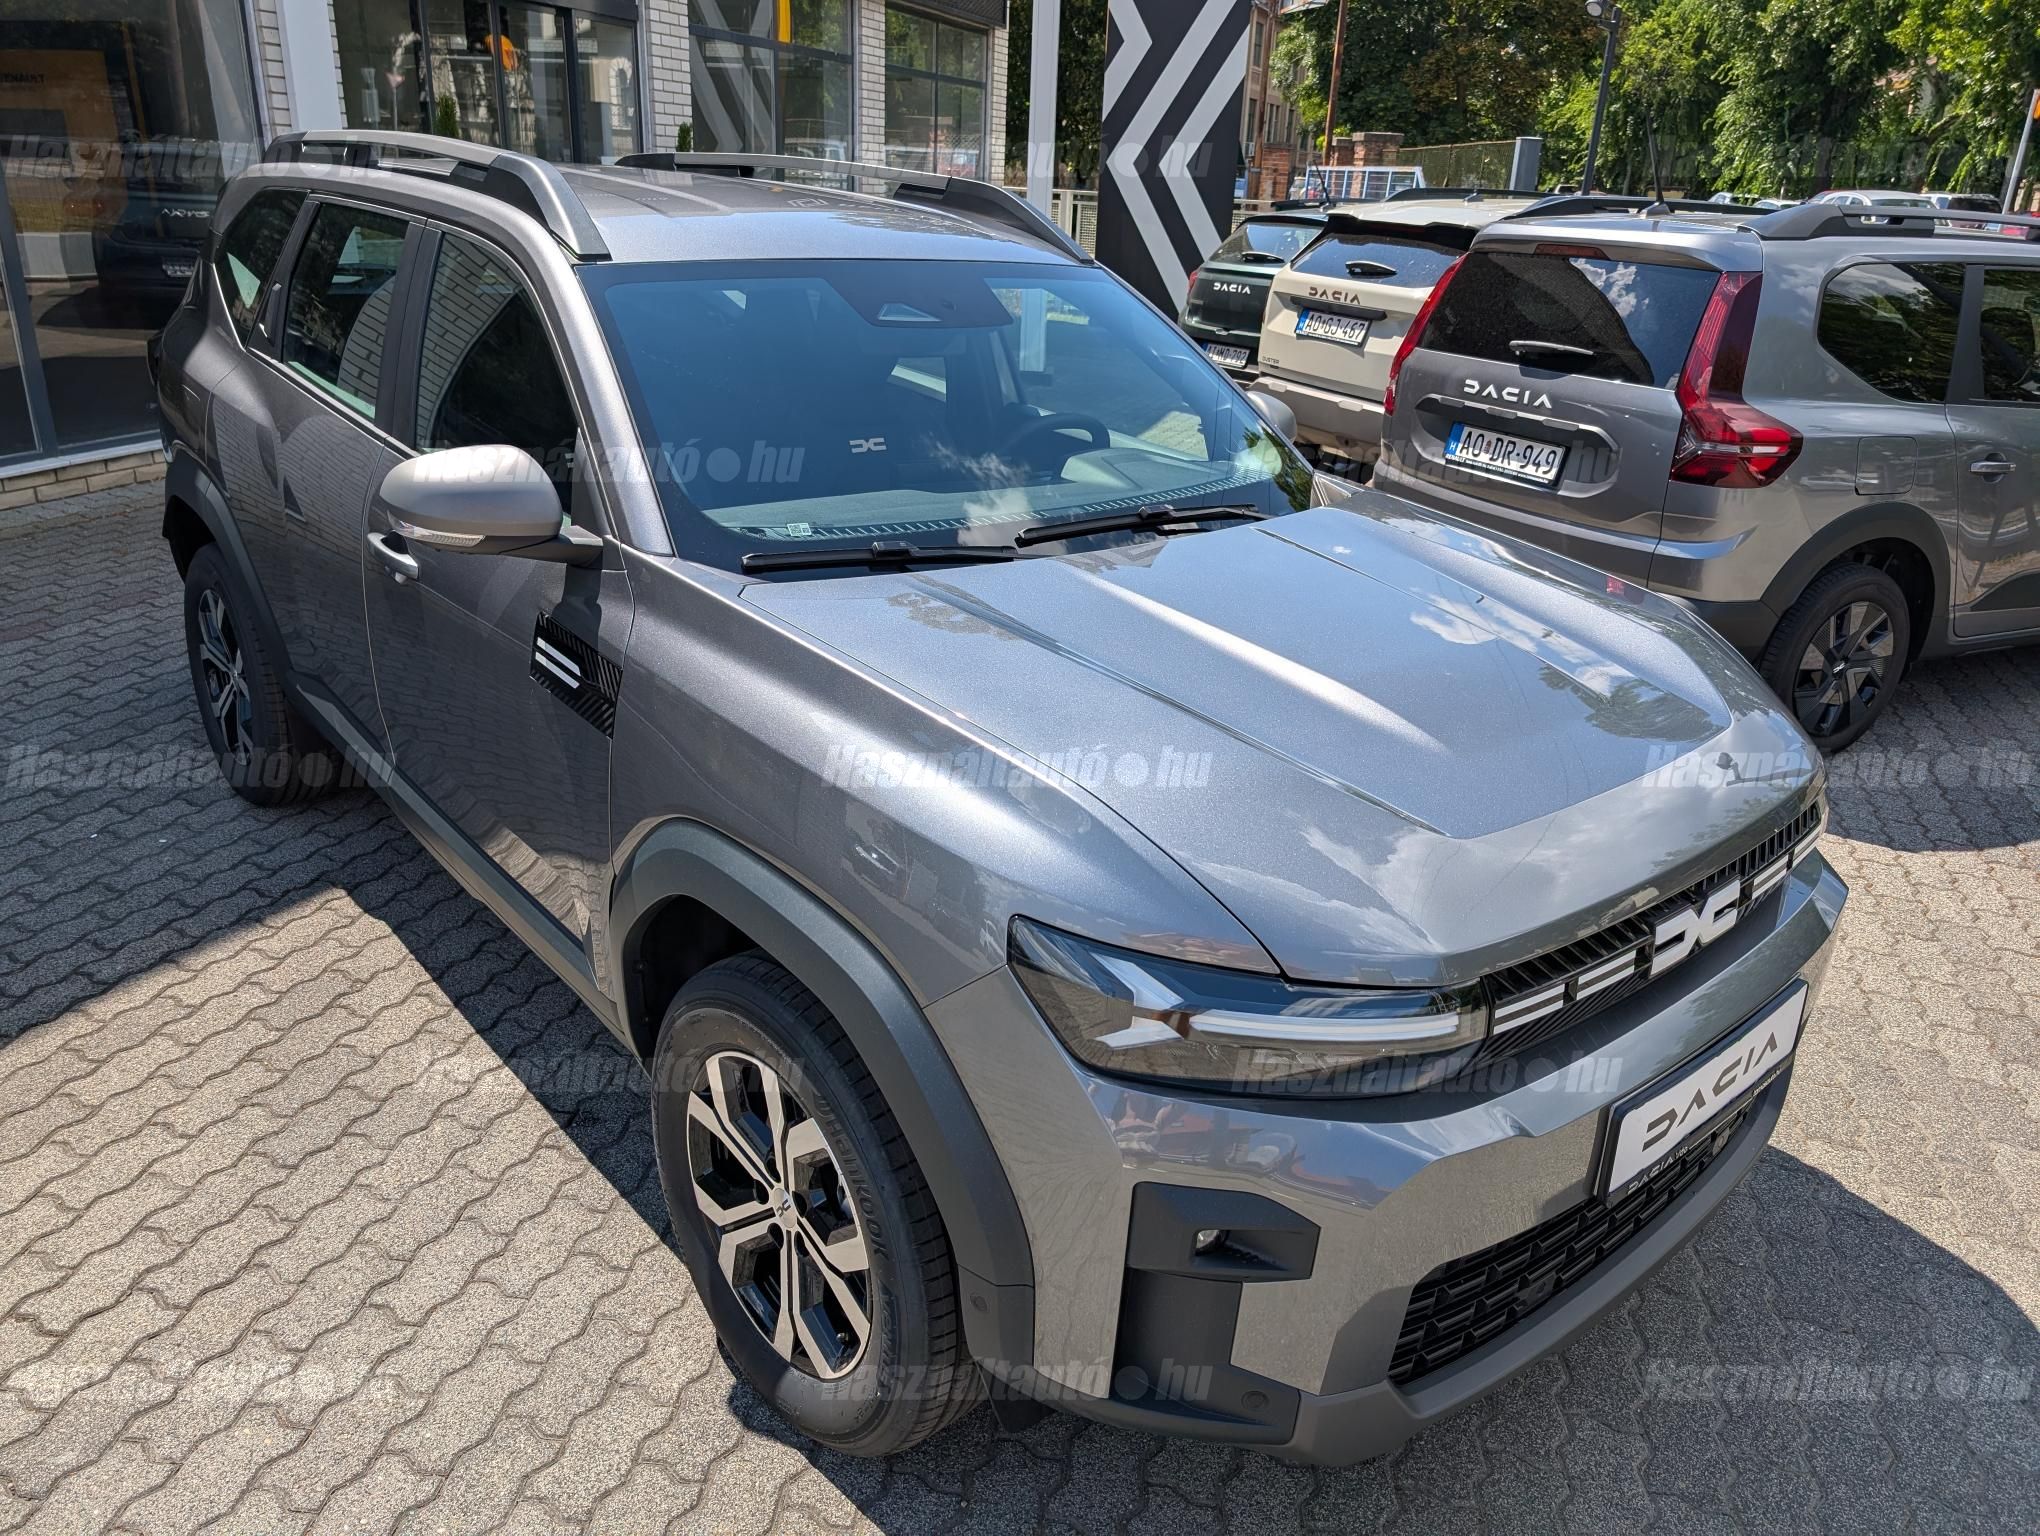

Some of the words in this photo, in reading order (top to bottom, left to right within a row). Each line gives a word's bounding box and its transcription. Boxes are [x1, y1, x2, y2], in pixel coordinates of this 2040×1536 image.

[1213, 282, 1251, 295] DACIA
[1309, 286, 1361, 304] DACIA
[1463, 379, 1552, 409] DACIA
[1642, 1031, 1778, 1153] DACIA
[1627, 1156, 1674, 1195] DACIA
